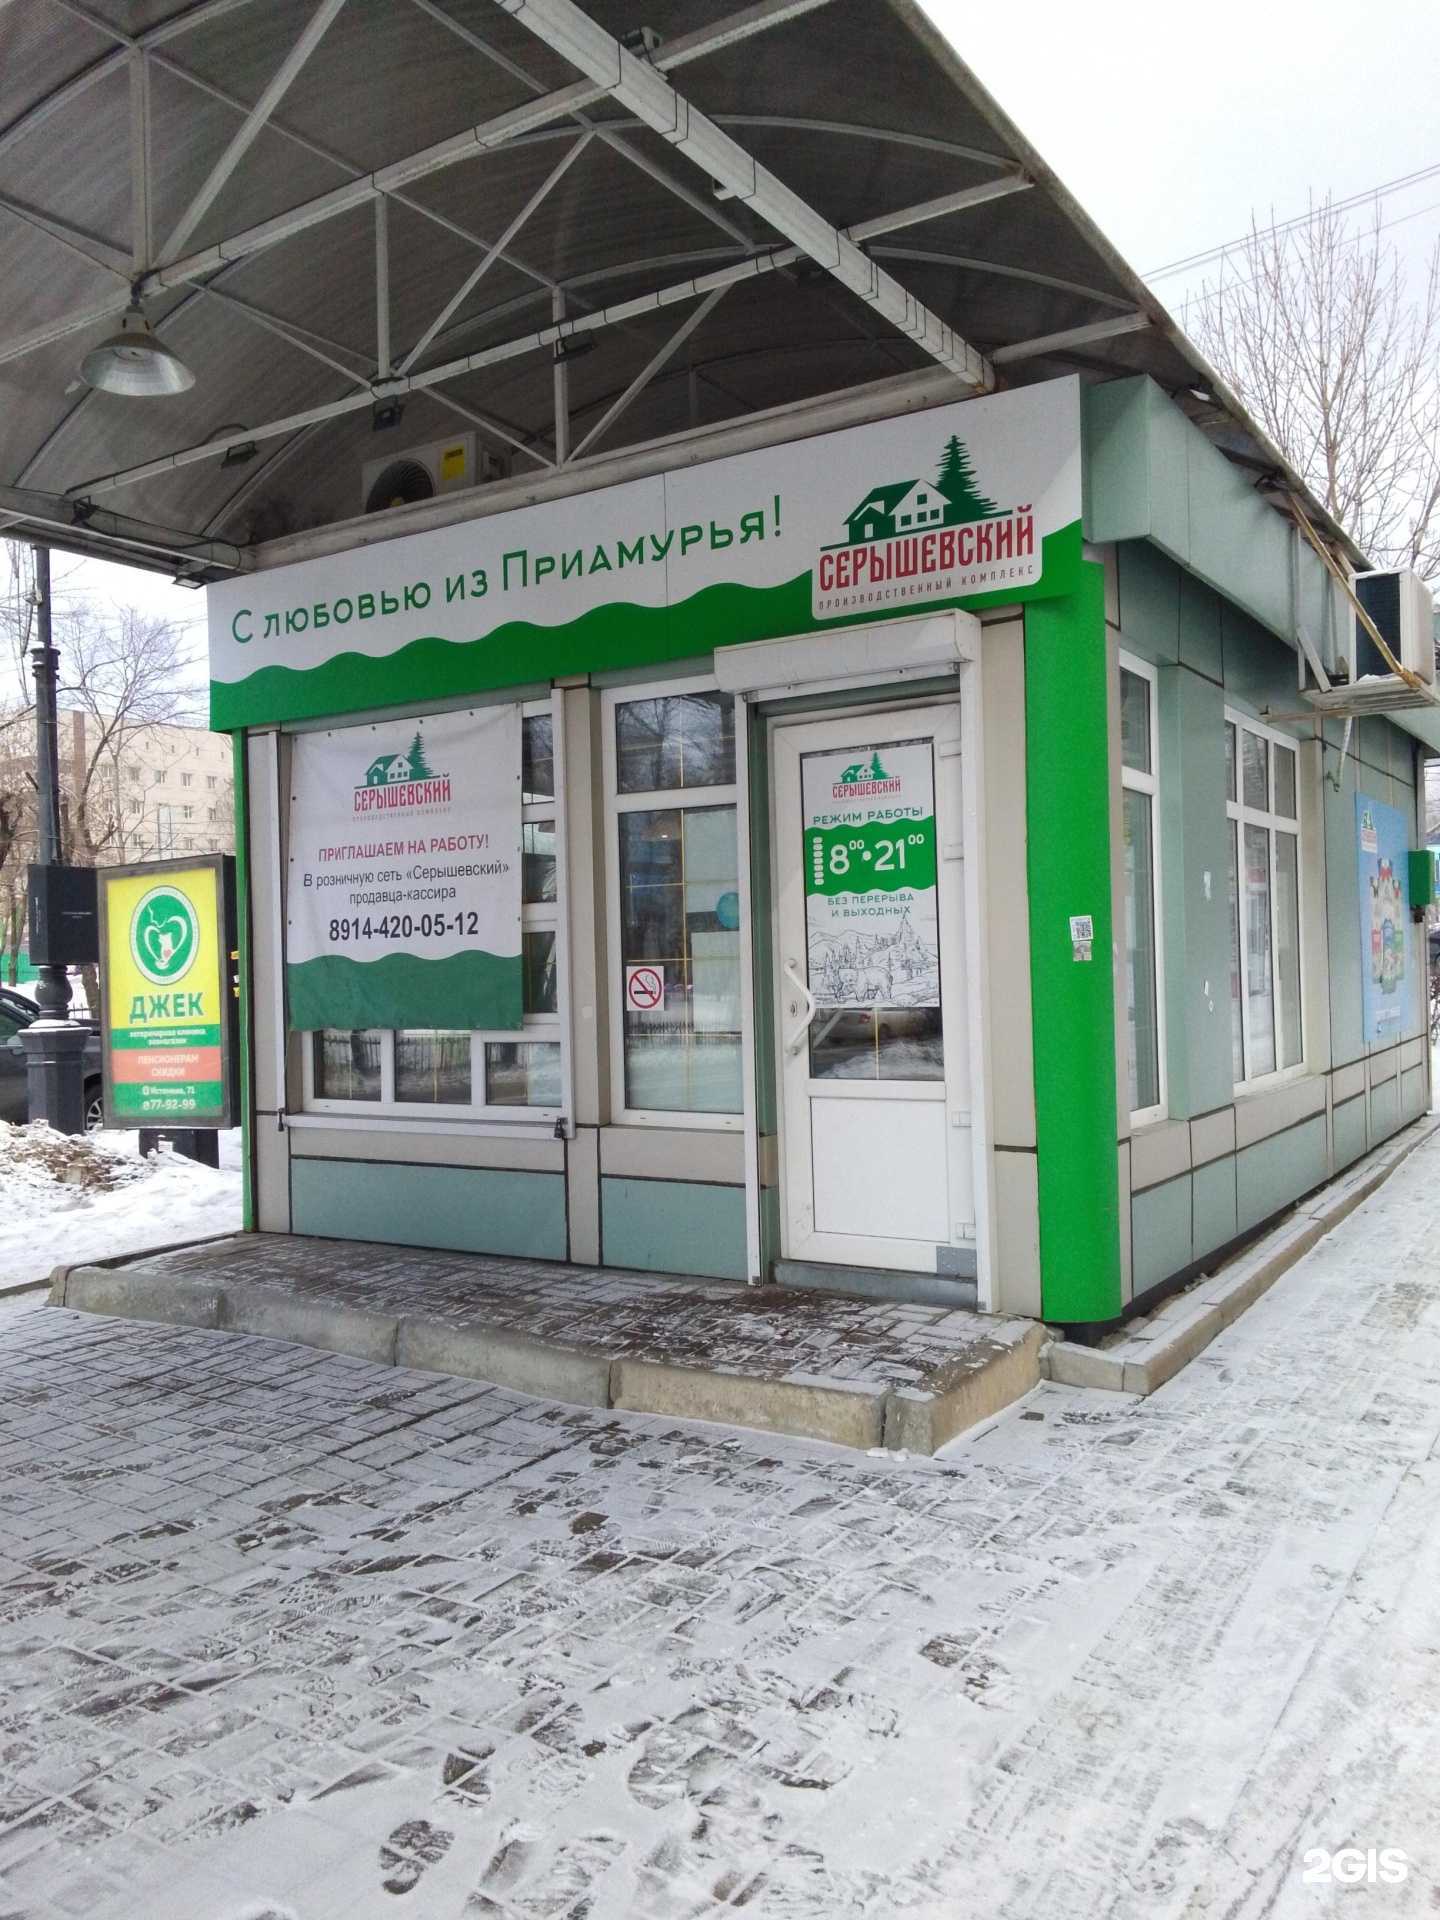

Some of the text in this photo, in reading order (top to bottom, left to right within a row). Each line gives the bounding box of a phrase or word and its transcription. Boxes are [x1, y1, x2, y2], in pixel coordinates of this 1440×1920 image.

[819, 504, 1033, 591] СЕРЫШЕВСКИЙ
[819, 564, 1034, 611] ПРОИЗВОДСТВЕННЫЙ КОМПЛЕКС
[232, 609, 253, 643] С
[354, 772, 451, 812] СЕРЫШЕВСКИЙ
[832, 775, 902, 799] СЕРЫШЕВСКИЙ
[813, 806, 923, 825] РЕЖИМ РАБОТЫ
[318, 833, 489, 862] ПРИГЛАШАЕМ НА РАБОТУ!
[303, 859, 509, 890] В розничную сеть «Серышевский»
[350, 886, 457, 907] продавца-кассира
[827, 893, 914, 906] БЕЗ ПЕРЕРЫВА
[831, 905, 911, 918] И ВЫХОДНЫХ
[329, 911, 479, 941] 8914-420-05-12
[129, 992, 204, 1024] ДЖЕК
